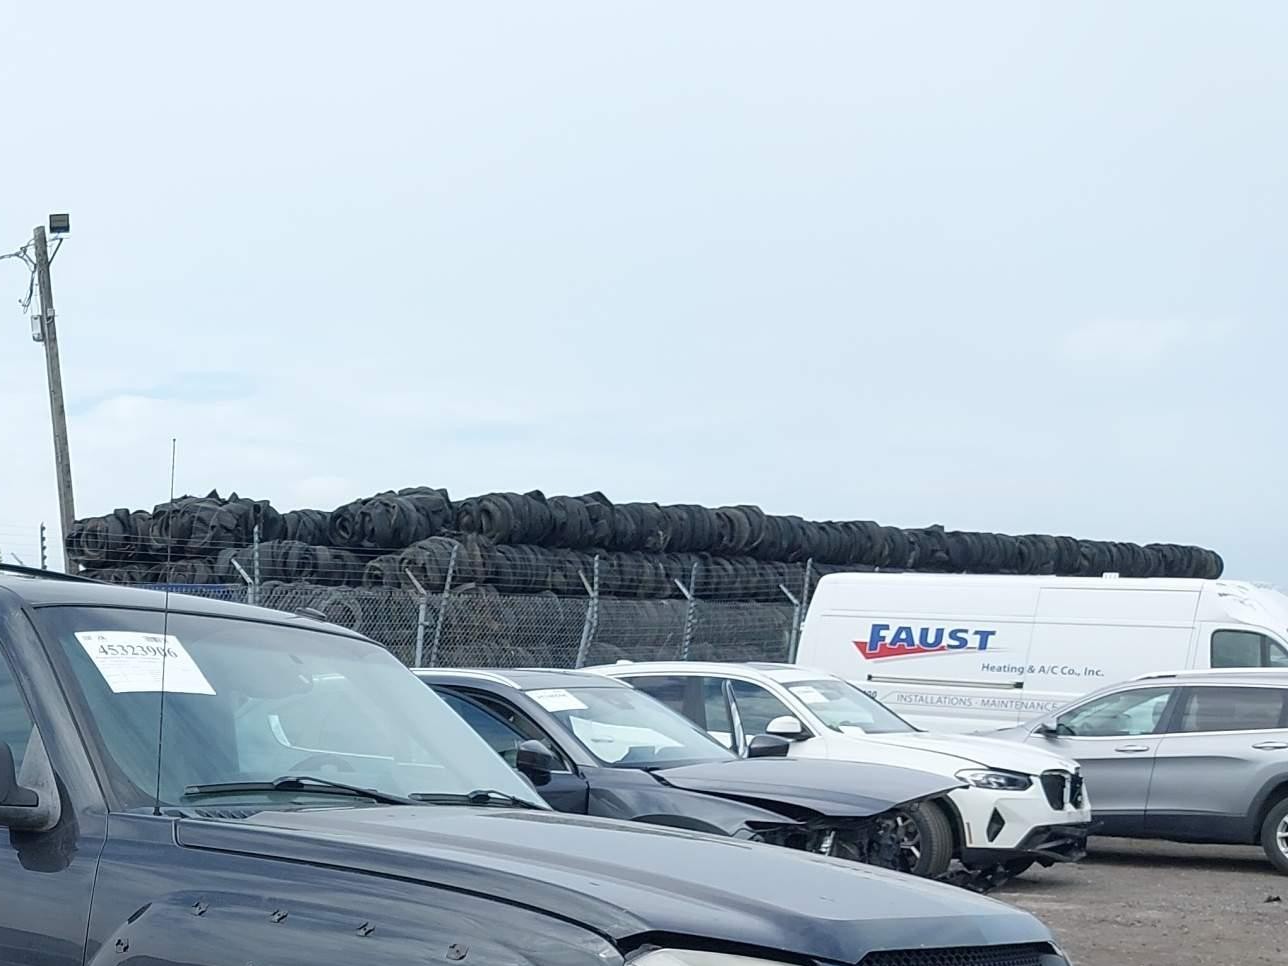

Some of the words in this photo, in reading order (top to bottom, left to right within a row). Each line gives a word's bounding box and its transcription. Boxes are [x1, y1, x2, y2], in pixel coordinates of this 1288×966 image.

[868, 624, 997, 652] FAUST
[98, 644, 179, 658] 45323906
[981, 663, 1025, 676] Heating
[1027, 664, 1036, 674] &
[1038, 664, 1059, 675] A/C
[1061, 665, 1081, 677] Co.,
[1084, 666, 1105, 677] Inc.
[896, 694, 973, 707] INSTALLATIONS
[980, 699, 1058, 712] MAINTENANCE
